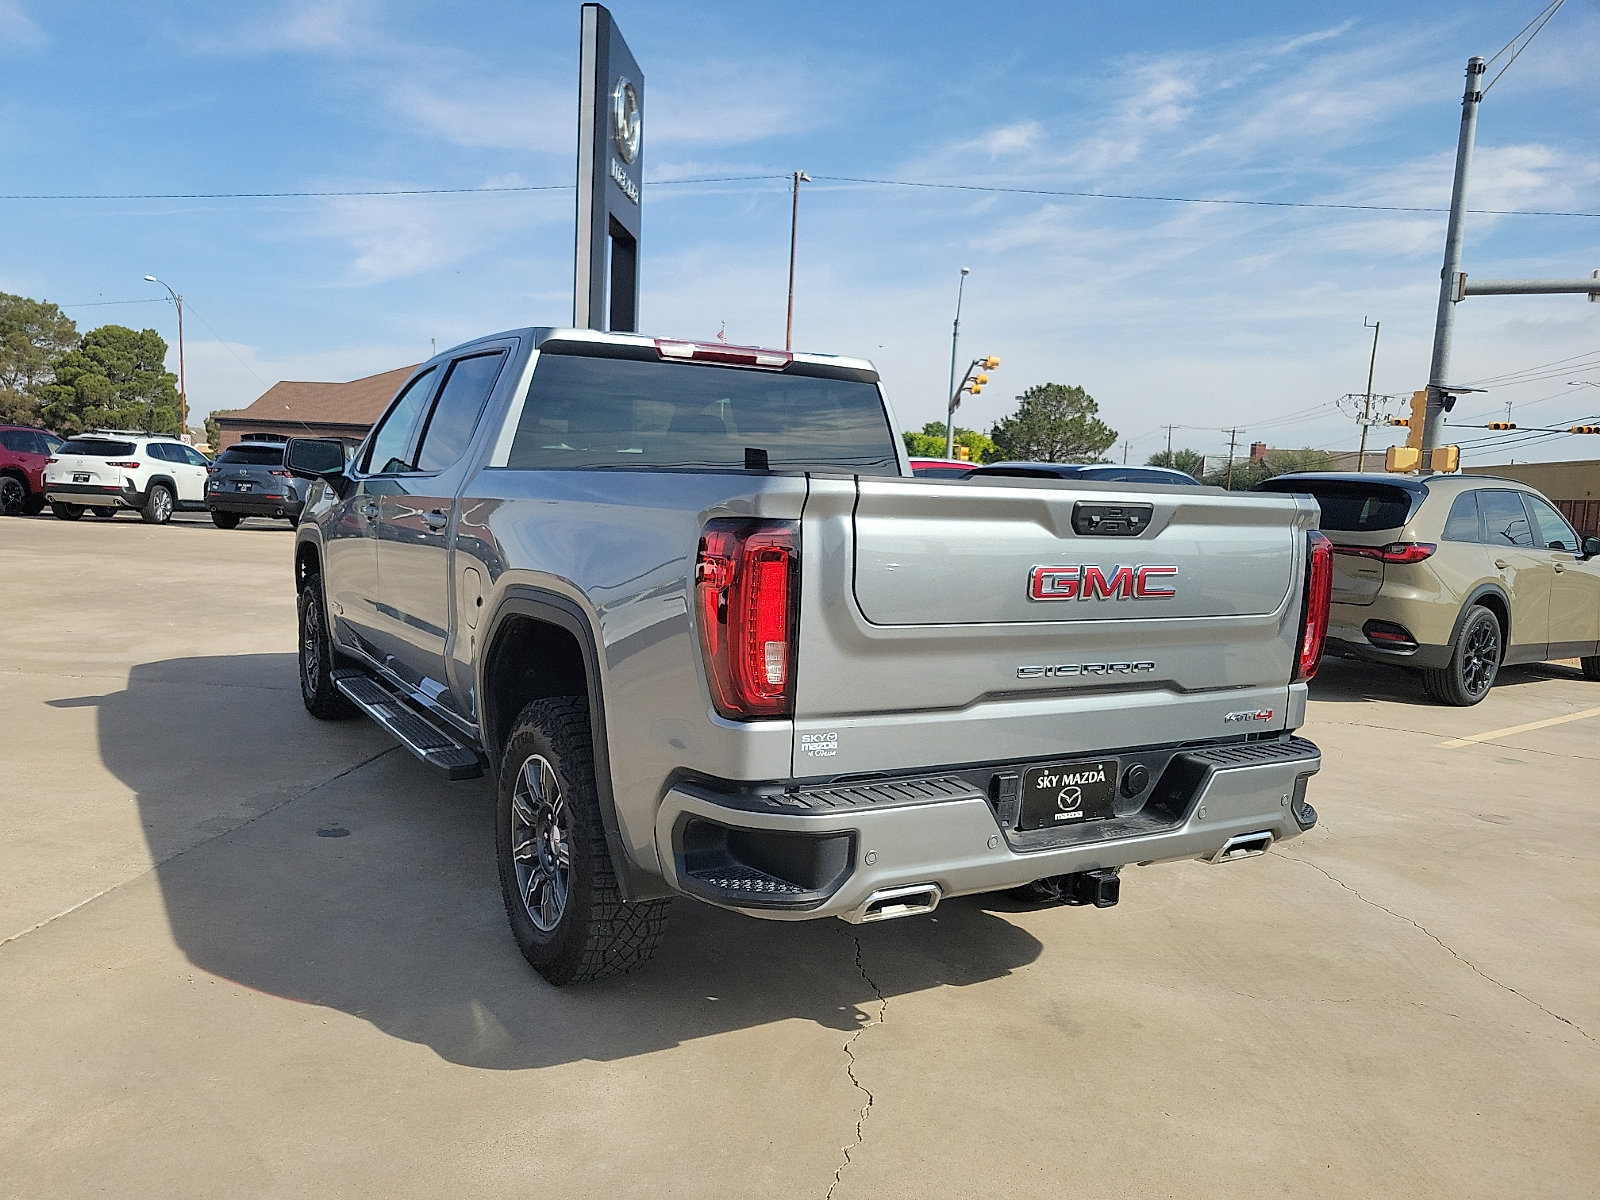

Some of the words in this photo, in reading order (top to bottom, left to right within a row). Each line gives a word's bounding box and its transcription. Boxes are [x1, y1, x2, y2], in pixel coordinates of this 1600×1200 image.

[1027, 564, 1178, 602] GMC
[1016, 660, 1155, 679] SIERRA
[802, 734, 827, 742] SKY
[1036, 775, 1059, 789] SKY
[1062, 770, 1105, 786] MAZDA
